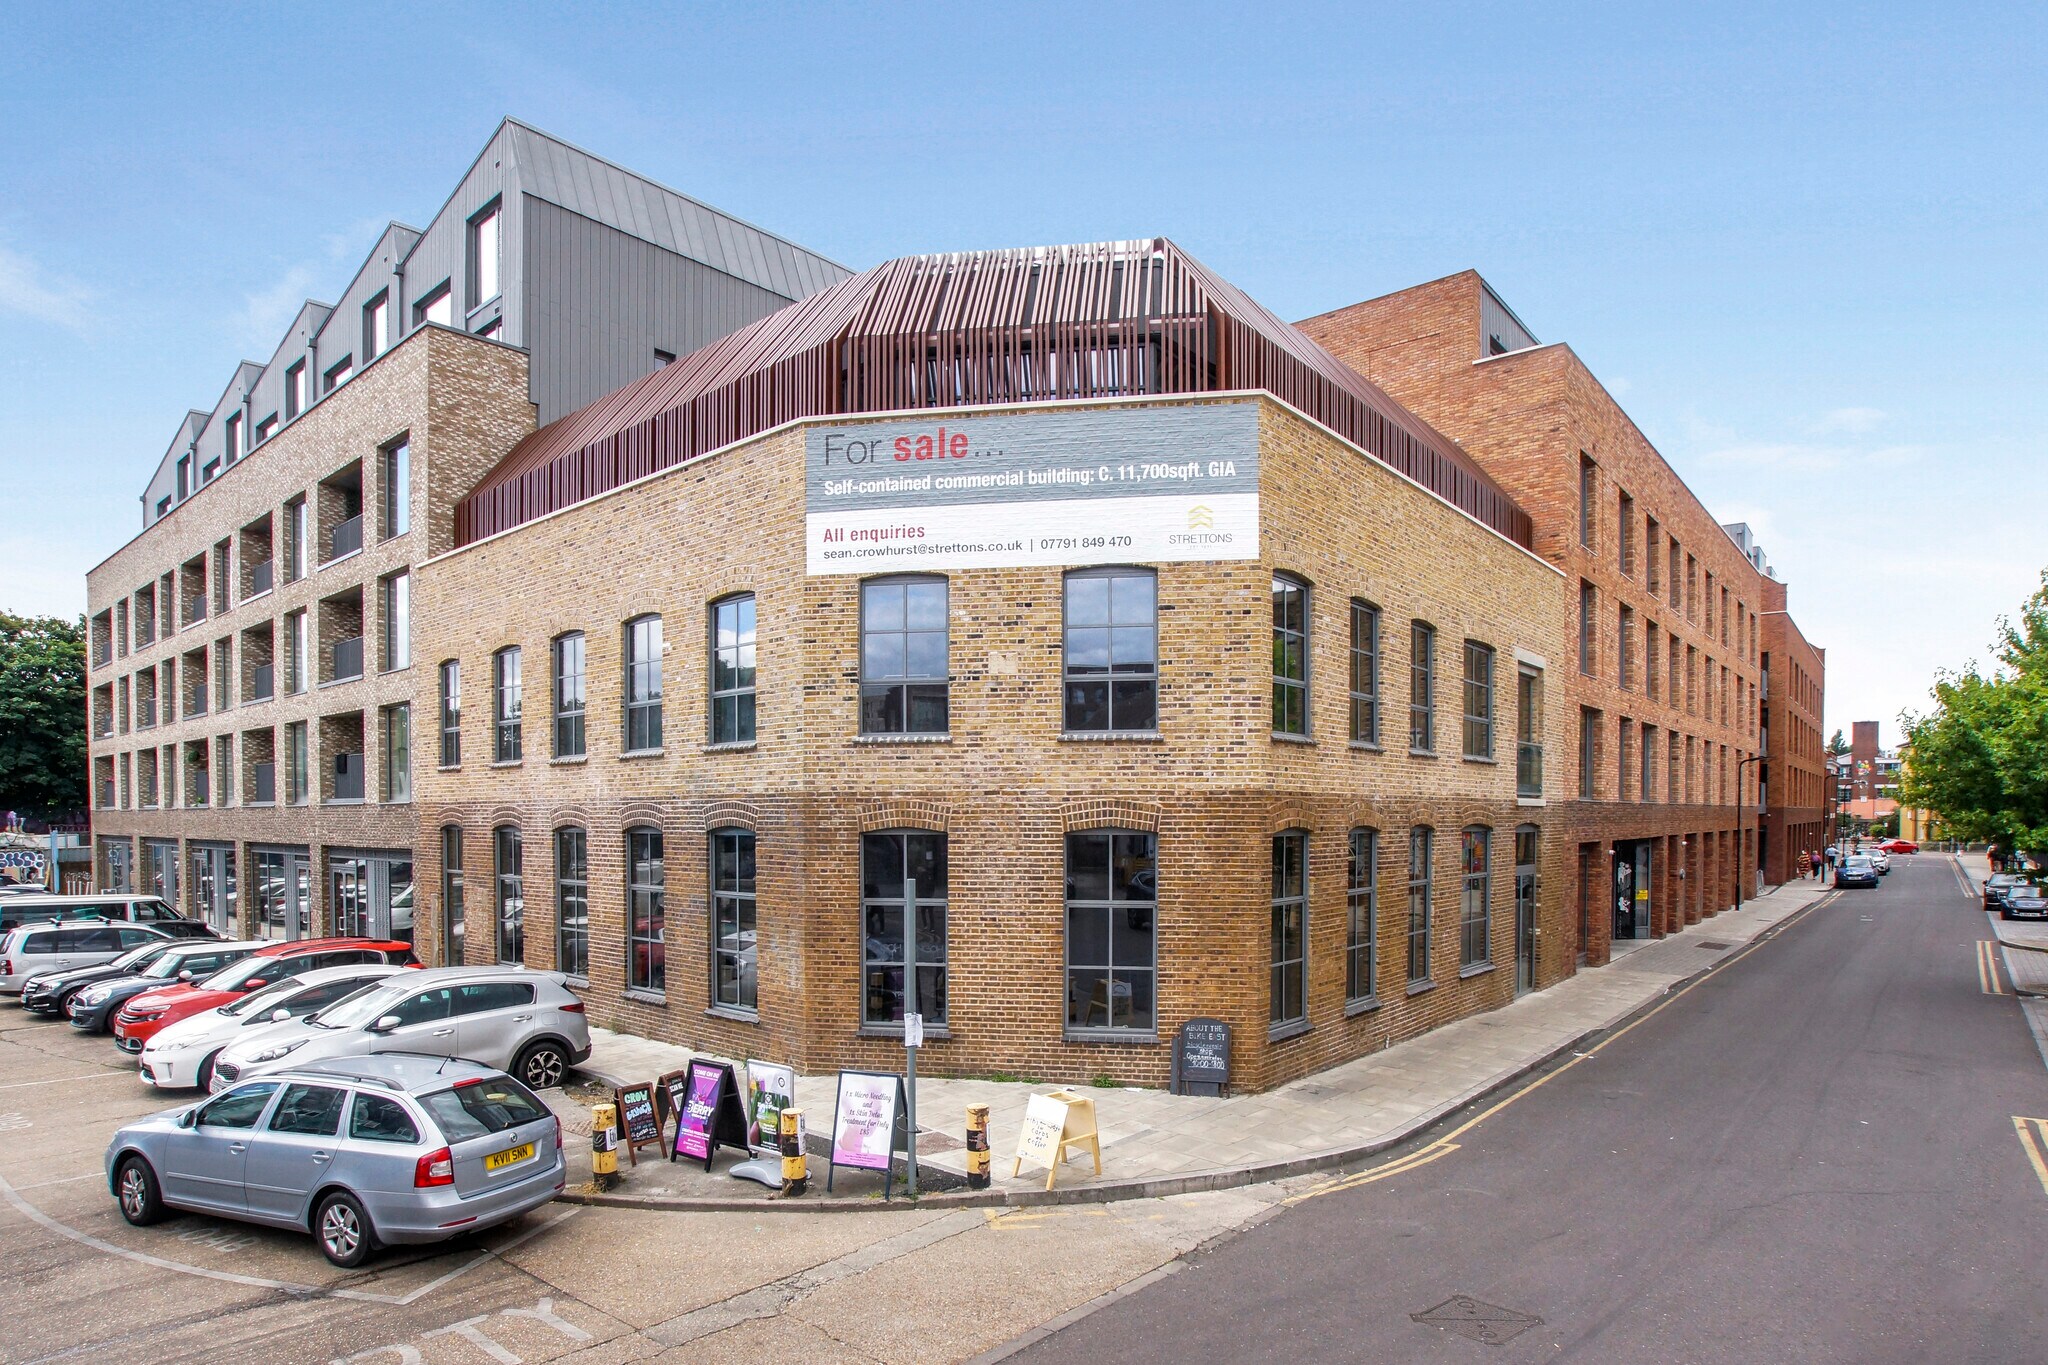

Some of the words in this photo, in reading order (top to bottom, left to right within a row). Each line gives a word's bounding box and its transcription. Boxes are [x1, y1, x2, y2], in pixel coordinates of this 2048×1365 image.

[825, 434, 882, 466] For
[893, 427, 1003, 462] sale...
[824, 475, 931, 496] Self-contained
[935, 470, 1024, 488] commercial
[1028, 467, 1095, 486] building:
[1098, 466, 1114, 482] C.
[1118, 462, 1204, 483] 11,700sqft.
[1208, 461, 1237, 478] GIA
[823, 528, 844, 543] All
[850, 524, 925, 543] enquiries
[1169, 532, 1233, 545] STRETTONS
[823, 540, 1023, 559] sean.crowhurst@strettons.co.uk
[1040, 538, 1077, 551] 07791
[1082, 536, 1105, 549] 849
[1109, 535, 1132, 548] 470
[1186, 1024, 1208, 1032] ABOUT
[1210, 1025, 1223, 1033] THE
[493, 1153, 511, 1166] KV11
[512, 1146, 528, 1160] SNN
